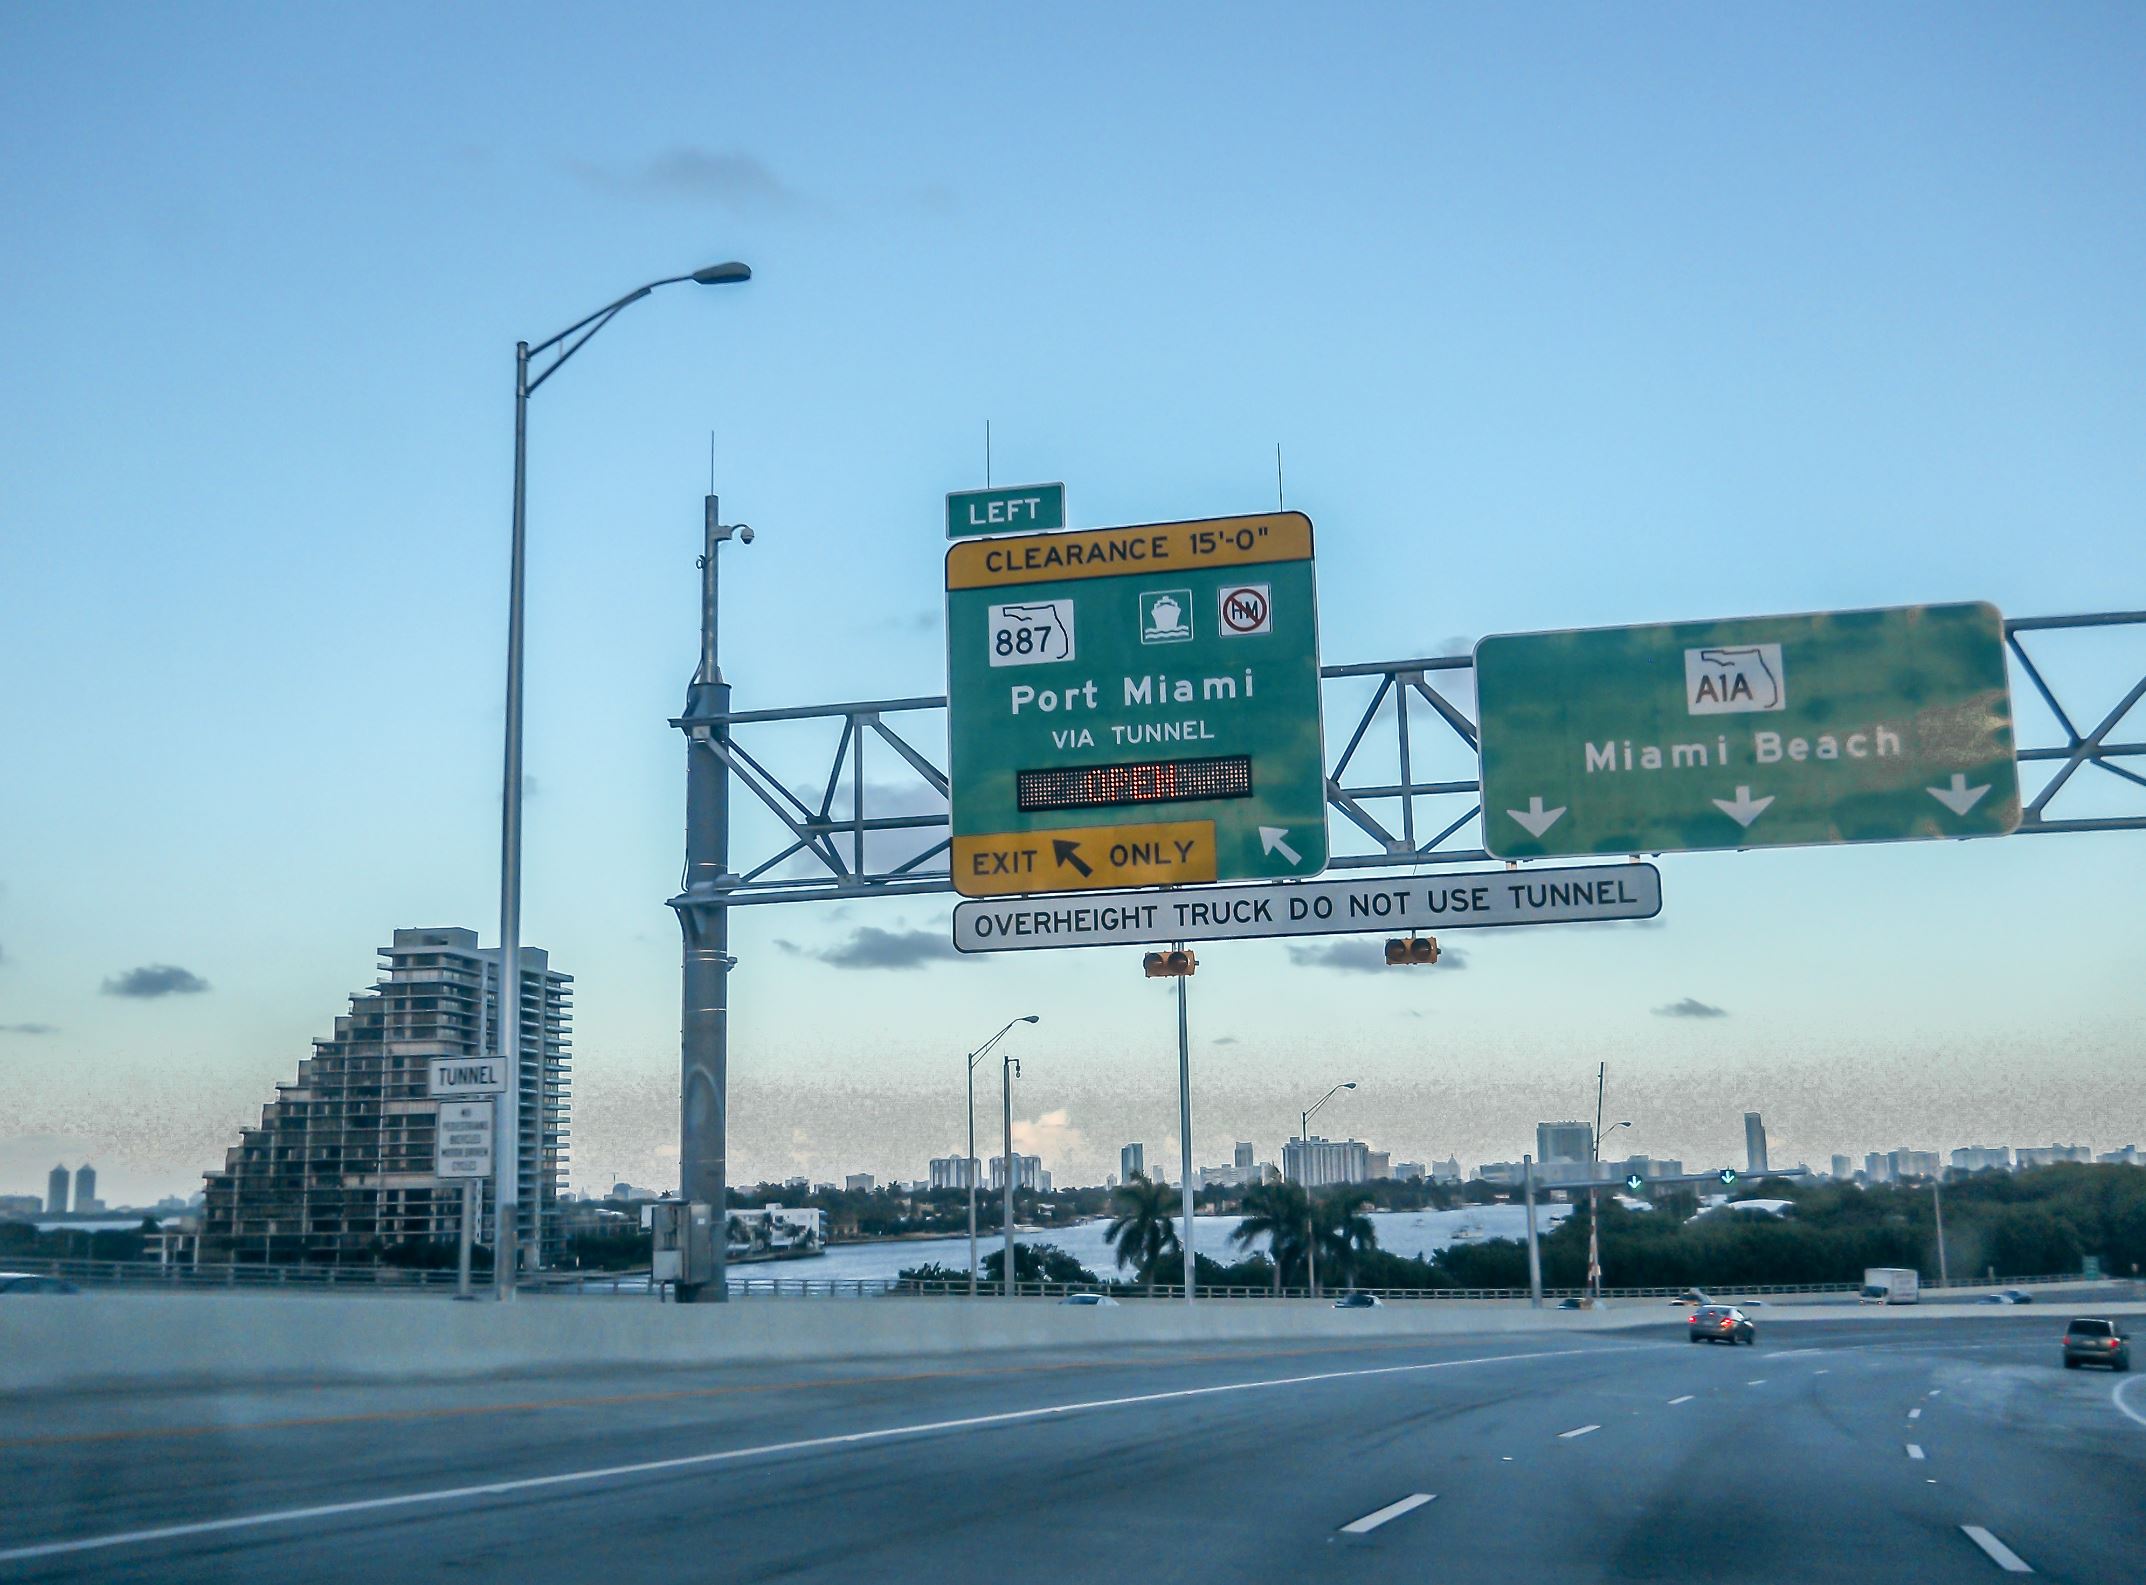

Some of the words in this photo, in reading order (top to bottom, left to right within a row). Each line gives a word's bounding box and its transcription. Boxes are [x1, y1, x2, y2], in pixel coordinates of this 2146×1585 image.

[969, 497, 1041, 525] LEFT
[986, 535, 1169, 573] CLEARANCE
[1189, 526, 1269, 555] 15'-0"
[995, 626, 1052, 657] 887
[1010, 679, 1098, 715] Port
[1123, 667, 1254, 706] Miami
[1695, 672, 1754, 704] A1A
[1051, 728, 1095, 750] VIA
[1111, 720, 1215, 746] TUNNEL
[1585, 735, 1728, 774] Miami
[1754, 725, 1901, 764] Beach
[1086, 763, 1176, 803] OPEN
[972, 849, 1038, 876] EXIT
[1109, 840, 1195, 868] ONLY
[974, 904, 1158, 938] OVERHEIGHT
[1173, 899, 1273, 928] TRUCK
[1289, 895, 1333, 921] DO
[1350, 891, 1411, 919] NOT
[1428, 887, 1490, 914] USE
[1508, 880, 1638, 910] TUNNEL
[439, 1065, 499, 1086] TUNNEL
